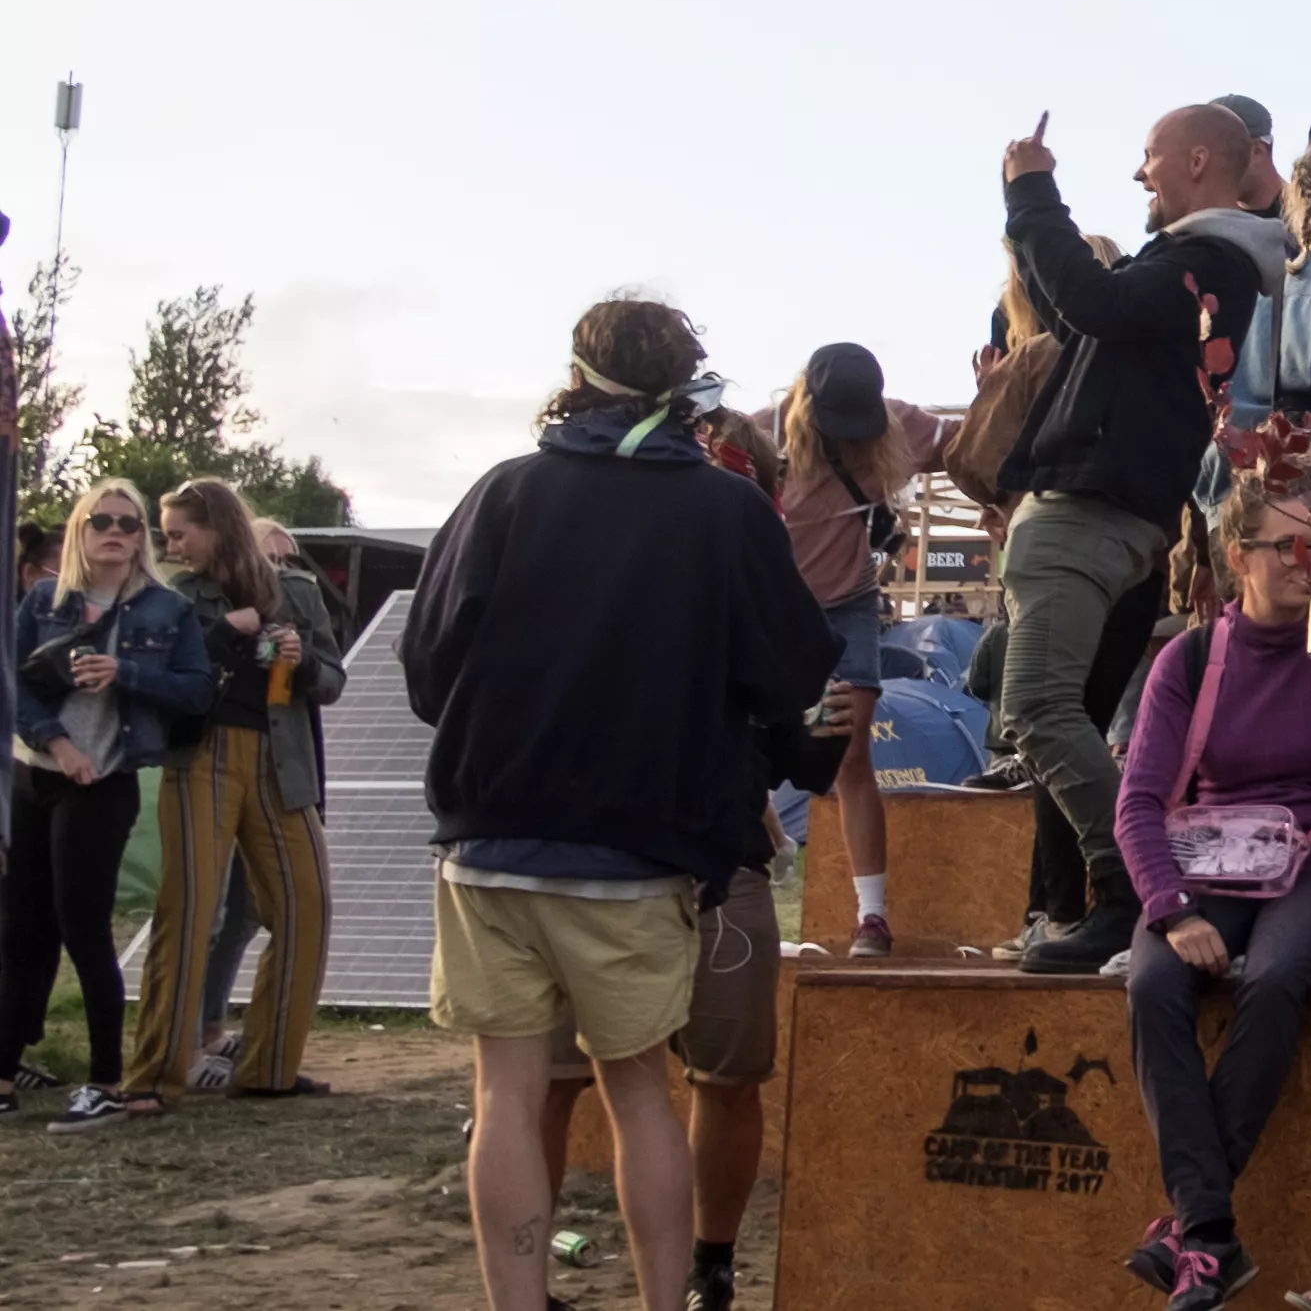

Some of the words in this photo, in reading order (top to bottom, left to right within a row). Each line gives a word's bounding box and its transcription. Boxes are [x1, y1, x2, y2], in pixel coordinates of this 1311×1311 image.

[926, 551, 965, 568] BEER
[1012, 1143, 1052, 1168] THE
[1057, 1146, 1111, 1172] YEAR
[1056, 1172, 1105, 1195] 2017
